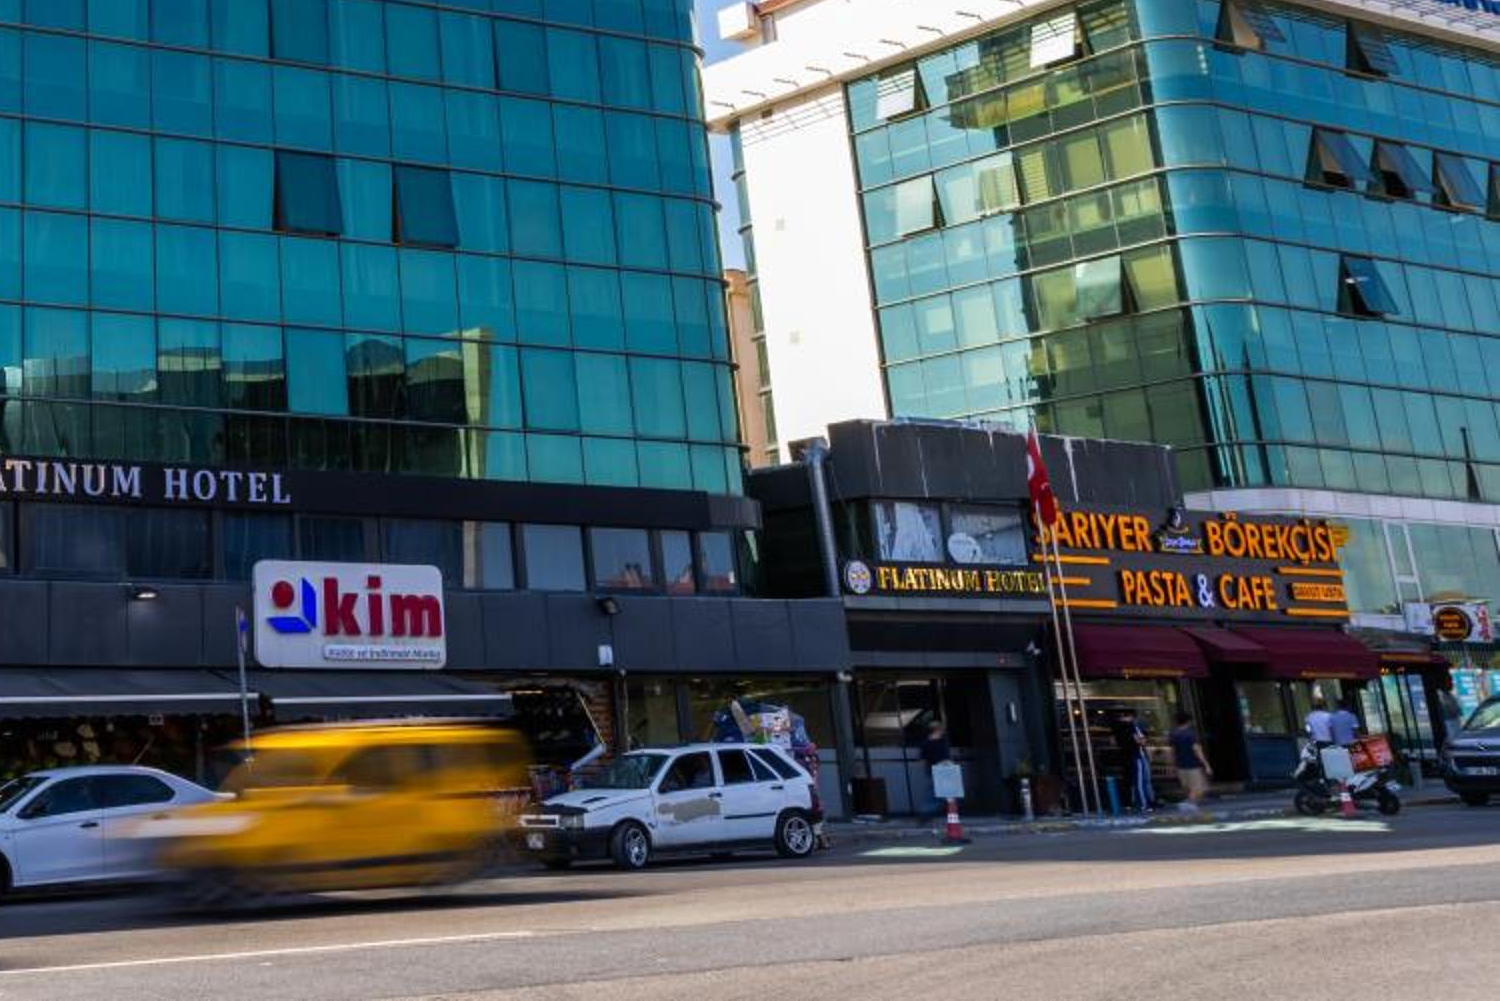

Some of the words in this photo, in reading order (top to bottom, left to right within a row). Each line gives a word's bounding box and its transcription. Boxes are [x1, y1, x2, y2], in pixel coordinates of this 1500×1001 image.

[163, 467, 292, 505] HOTEL
[876, 566, 981, 592] PLATINUM
[984, 570, 1046, 593] HOTEL
[1121, 569, 1193, 608] PASTA
[1197, 574, 1213, 609] &
[1219, 574, 1277, 610] CAFE
[323, 575, 443, 638] kim
